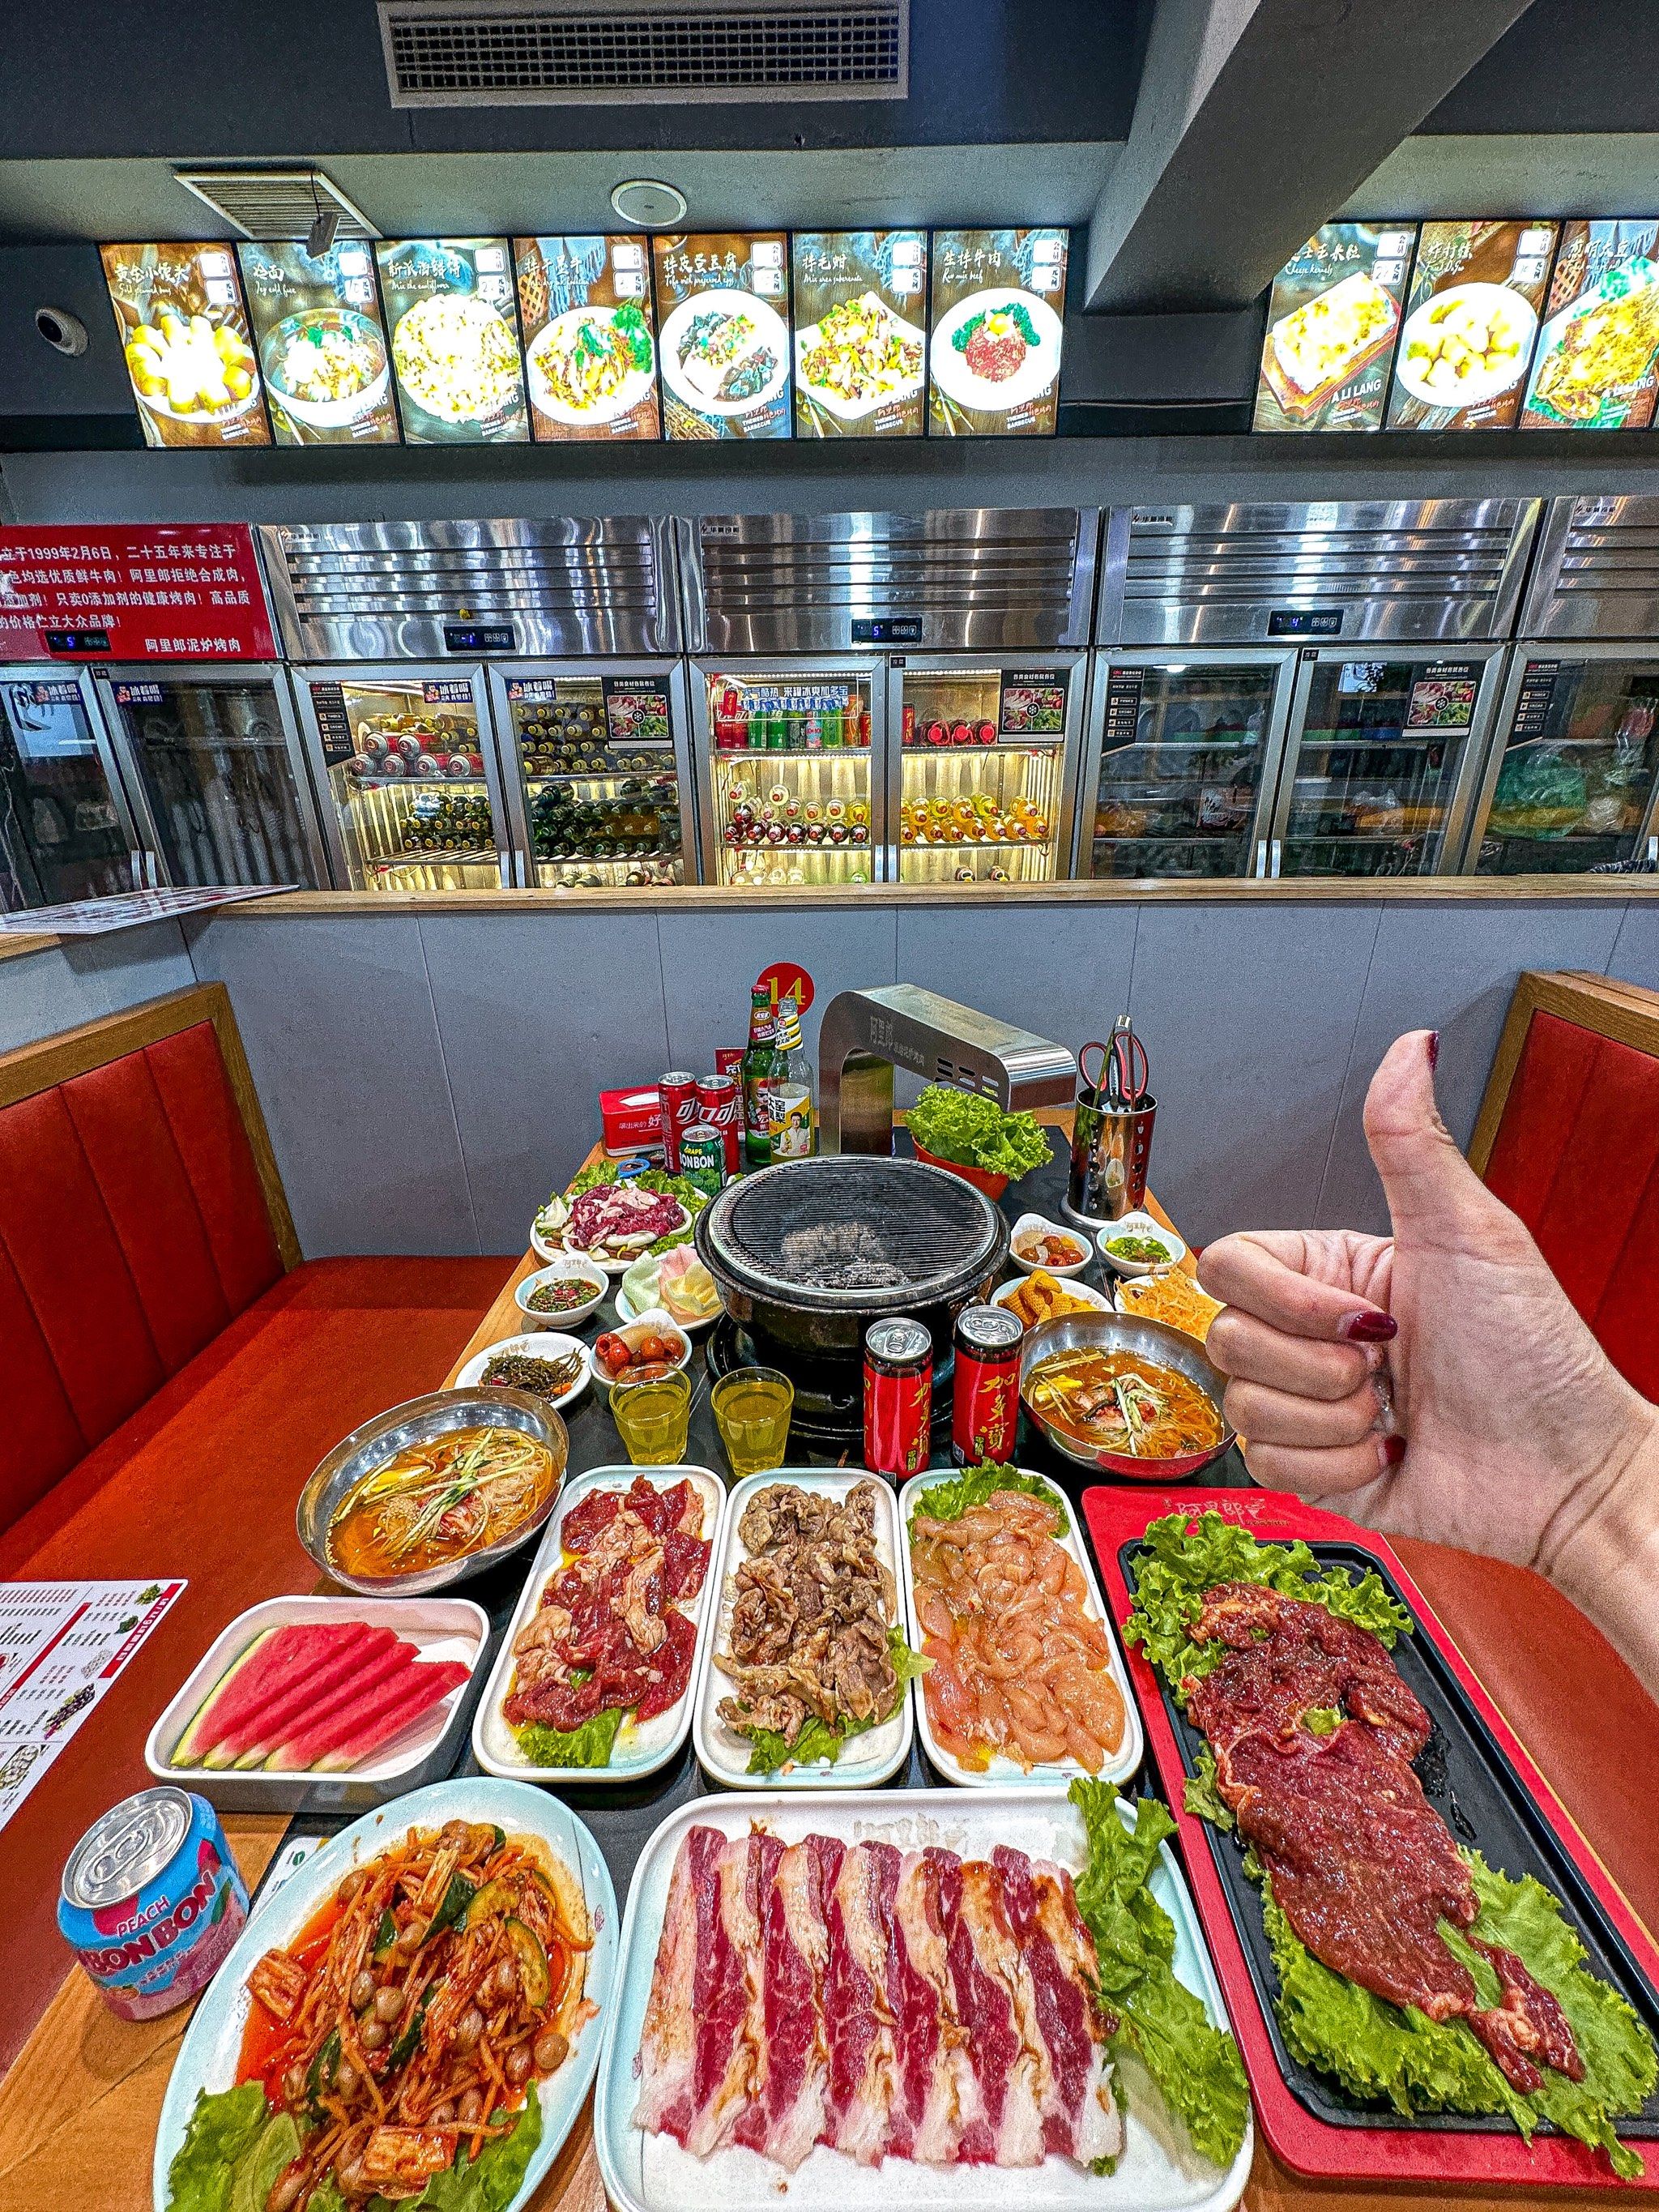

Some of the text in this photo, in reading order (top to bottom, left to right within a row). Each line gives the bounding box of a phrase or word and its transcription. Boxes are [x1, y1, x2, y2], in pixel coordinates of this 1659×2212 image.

[943, 249, 1001, 269] 生拌牛肉
[253, 263, 284, 281] 冷面
[1353, 379, 1381, 397] LANG
[126, 544, 236, 560] 二十五年来专注于
[209, 590, 250, 605] 高品质
[145, 638, 241, 652] 阿里郎泥炉烤肉
[742, 685, 848, 698] 天气酷热 来罐冰爽加多宝
[766, 977, 806, 1006] 14
[684, 1147, 702, 1155] GRAPE
[78, 1870, 216, 1977] BONBON
[116, 1894, 171, 1937] PEACH
